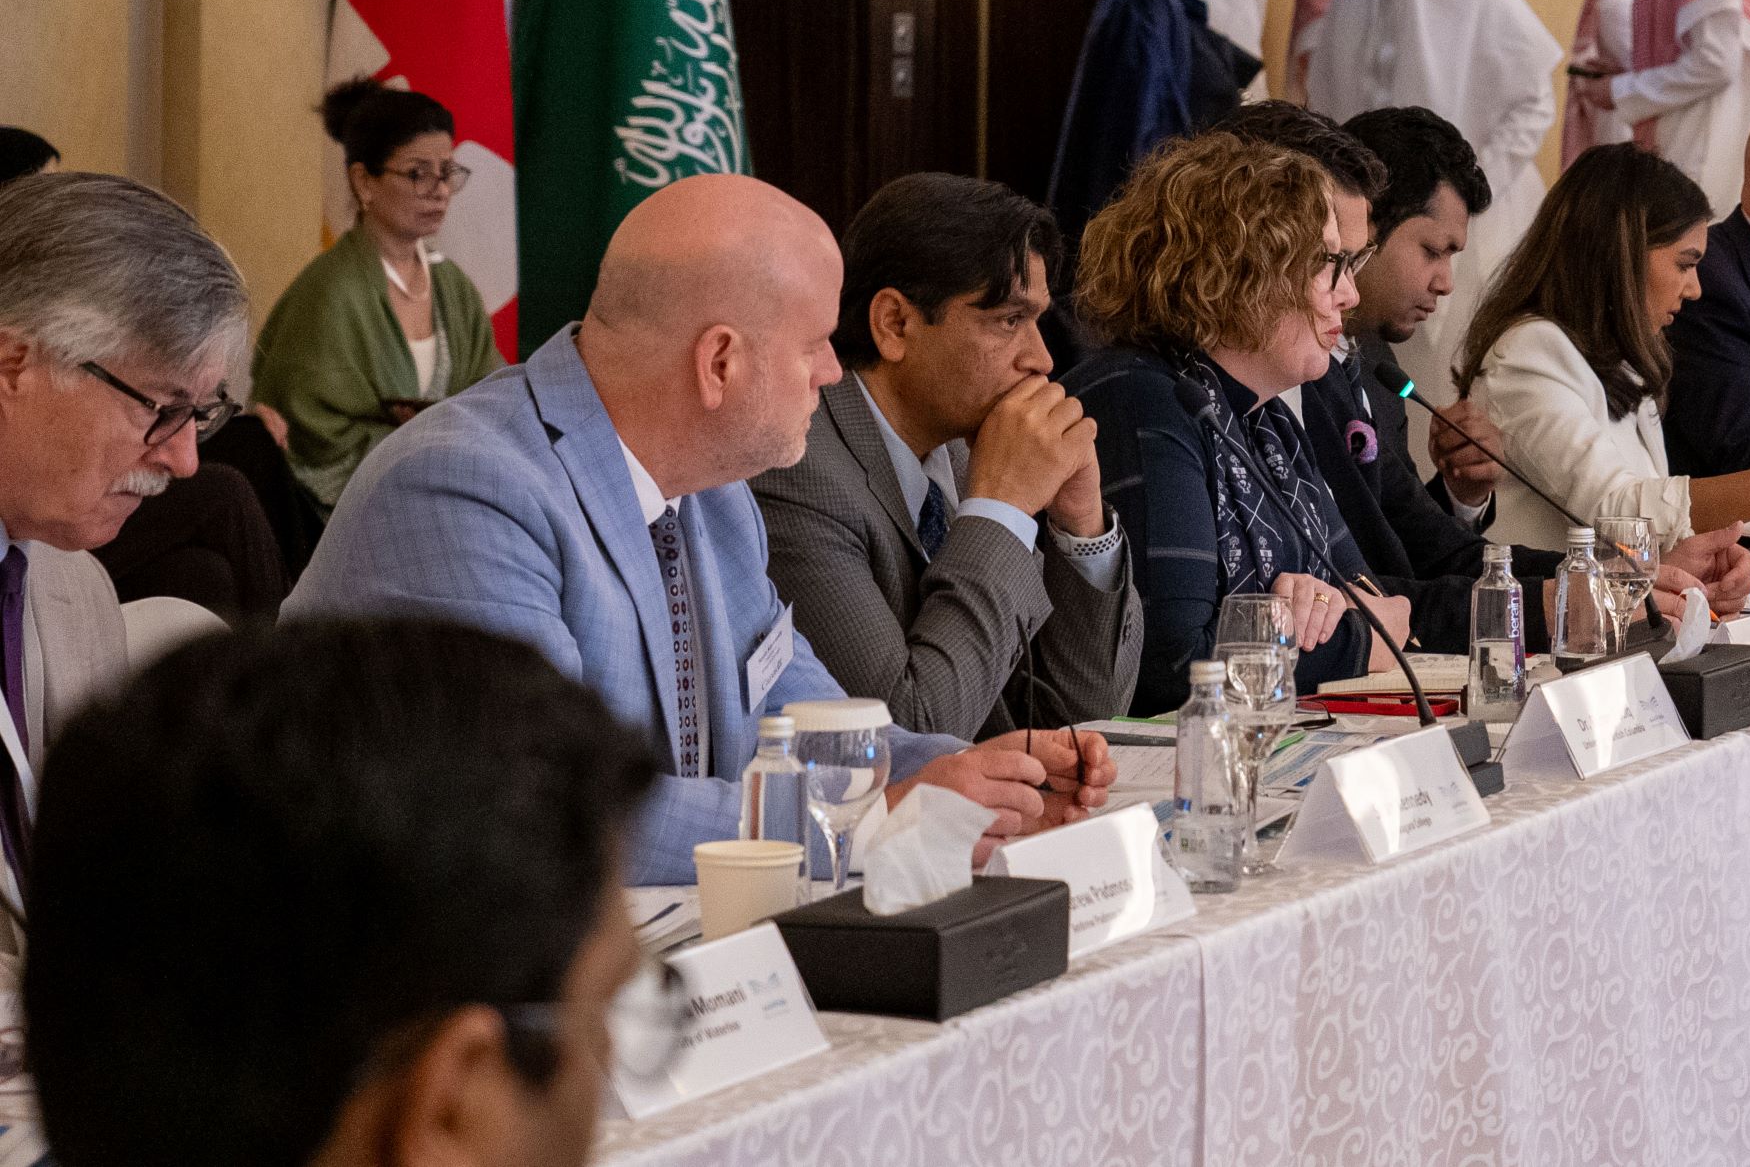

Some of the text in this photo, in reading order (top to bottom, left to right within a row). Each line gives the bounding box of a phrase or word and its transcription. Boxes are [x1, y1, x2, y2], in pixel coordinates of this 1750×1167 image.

[1507, 595, 1520, 638] berain
[1399, 787, 1433, 812] ennedy
[690, 983, 747, 1016] Momani
